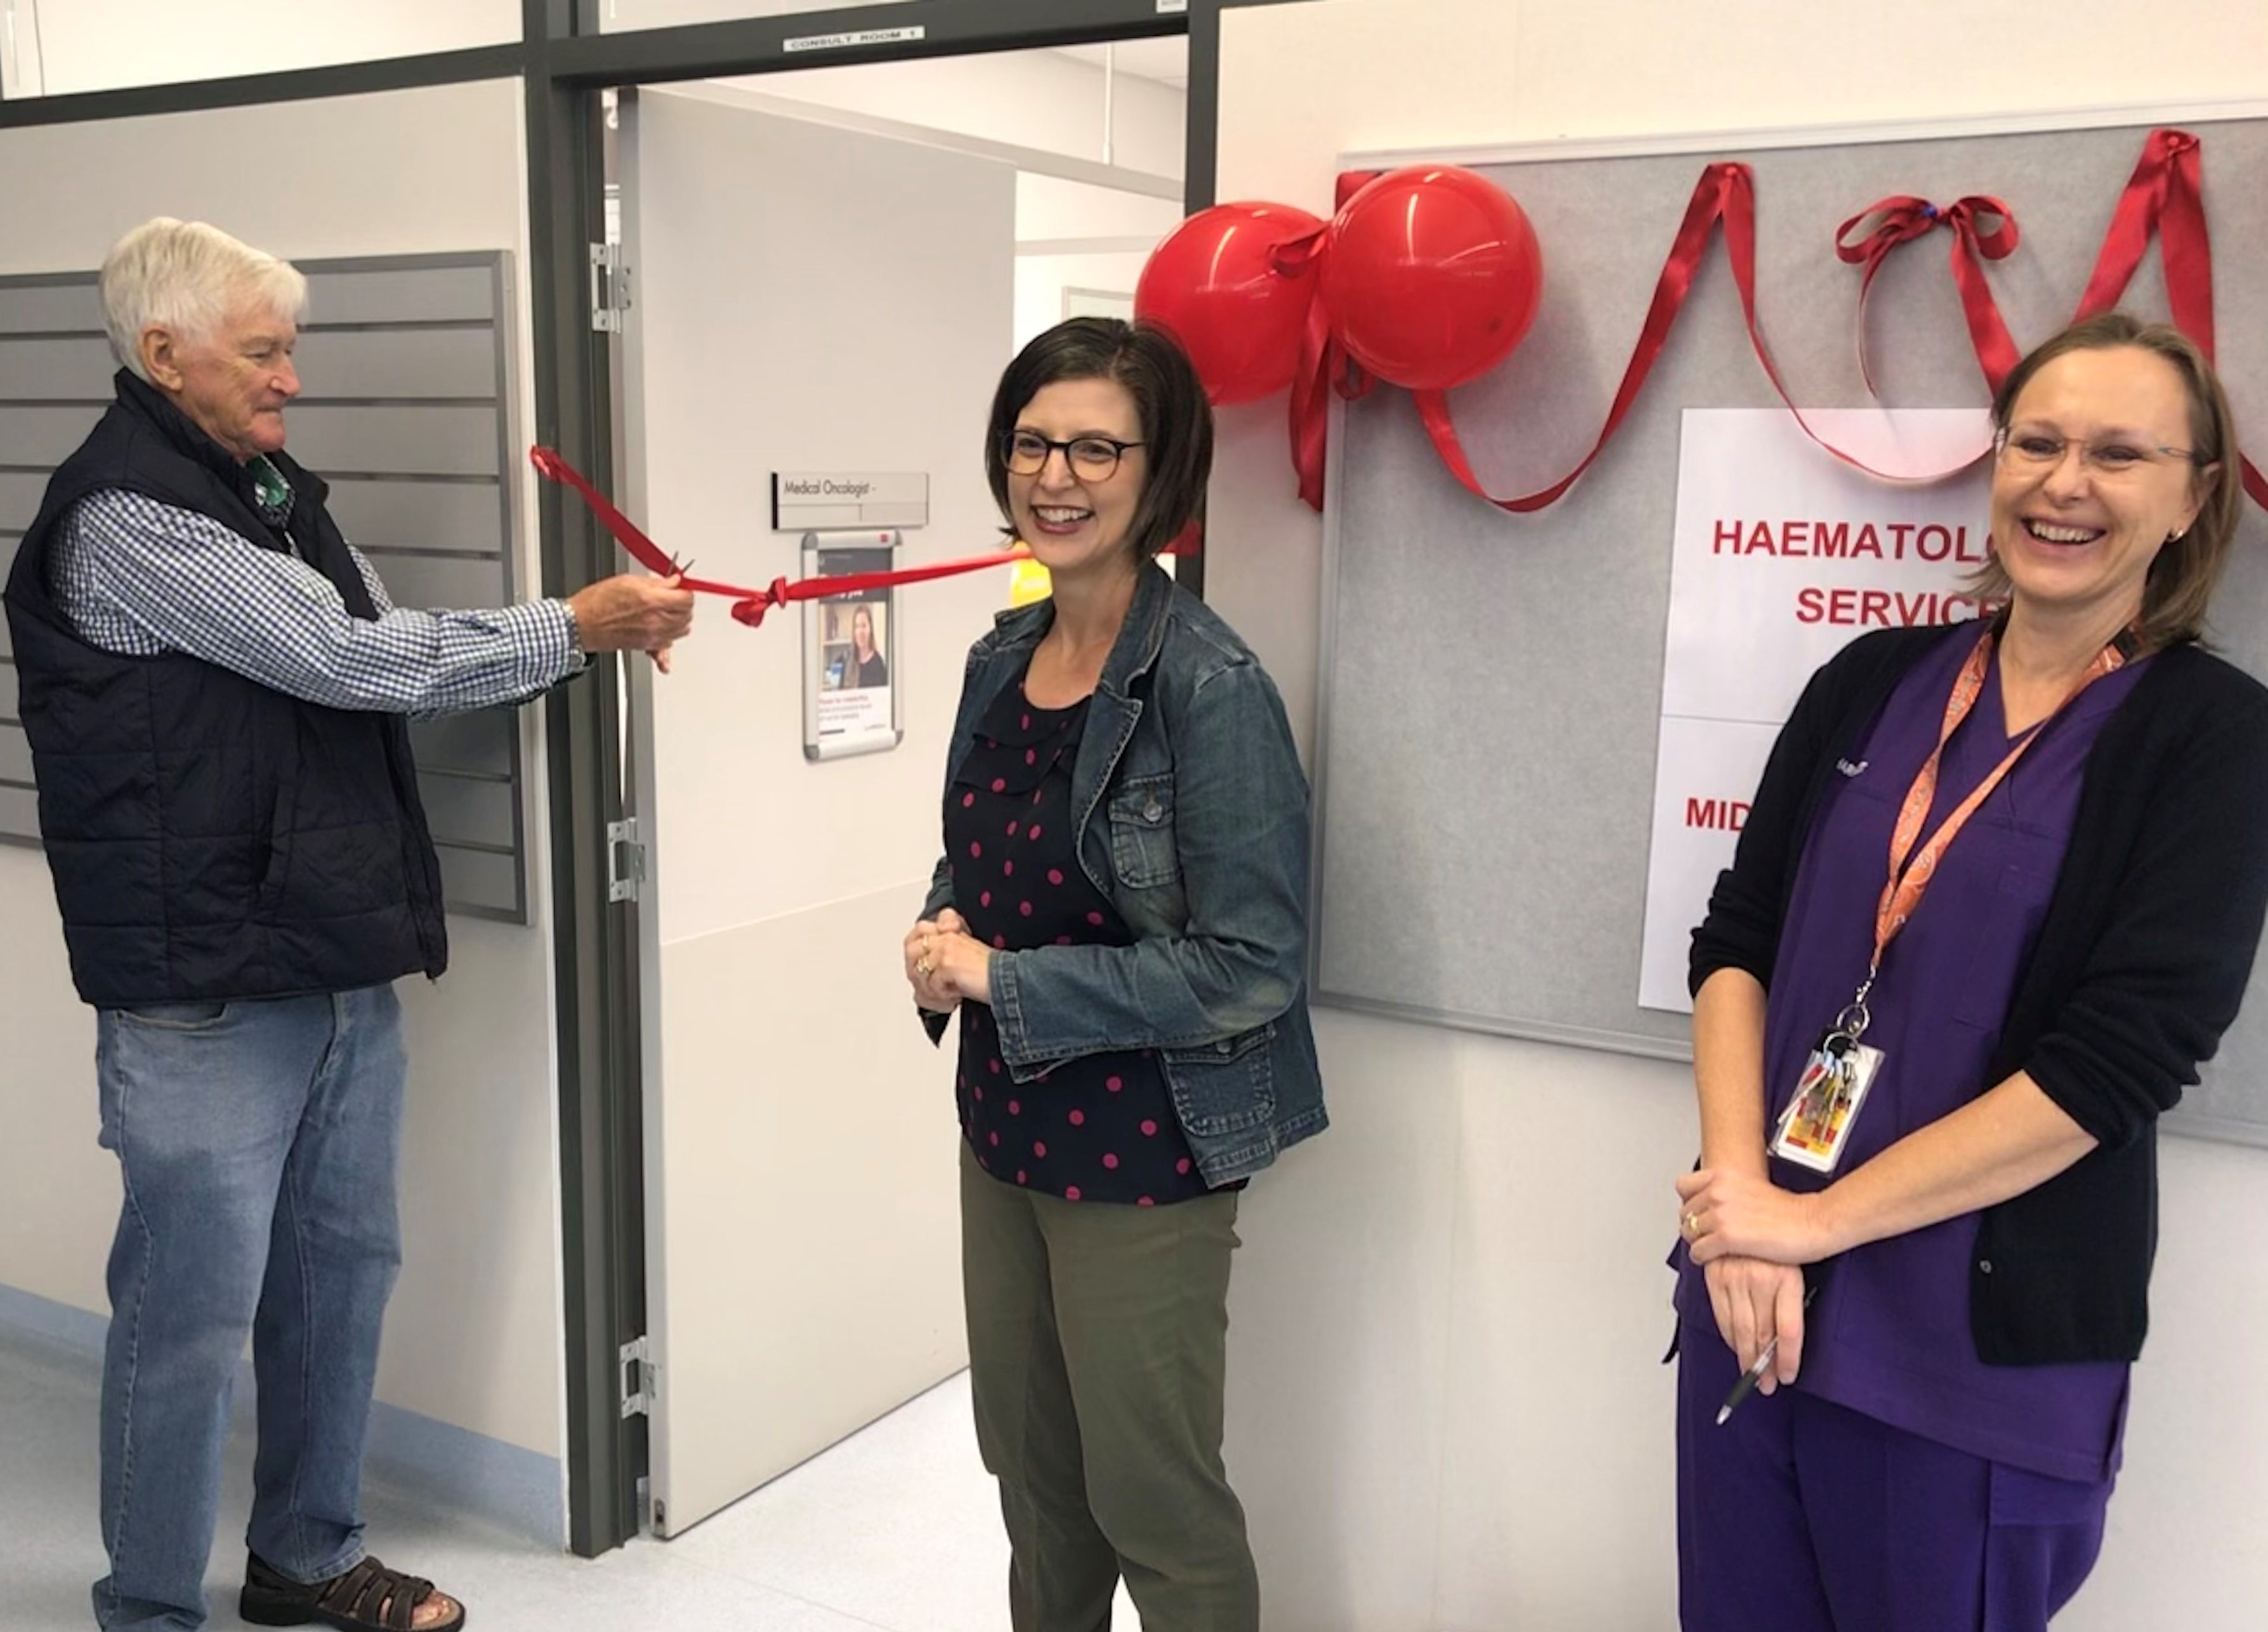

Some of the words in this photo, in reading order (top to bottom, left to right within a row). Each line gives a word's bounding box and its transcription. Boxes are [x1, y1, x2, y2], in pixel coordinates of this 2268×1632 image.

[791, 35, 851, 50] CONSULT
[860, 30, 902, 42] ROOM
[784, 480, 821, 495] Medical
[823, 480, 870, 499] Oncologist
[1714, 520, 1994, 563] HAEMATOL
[1686, 797, 1752, 832] MID
